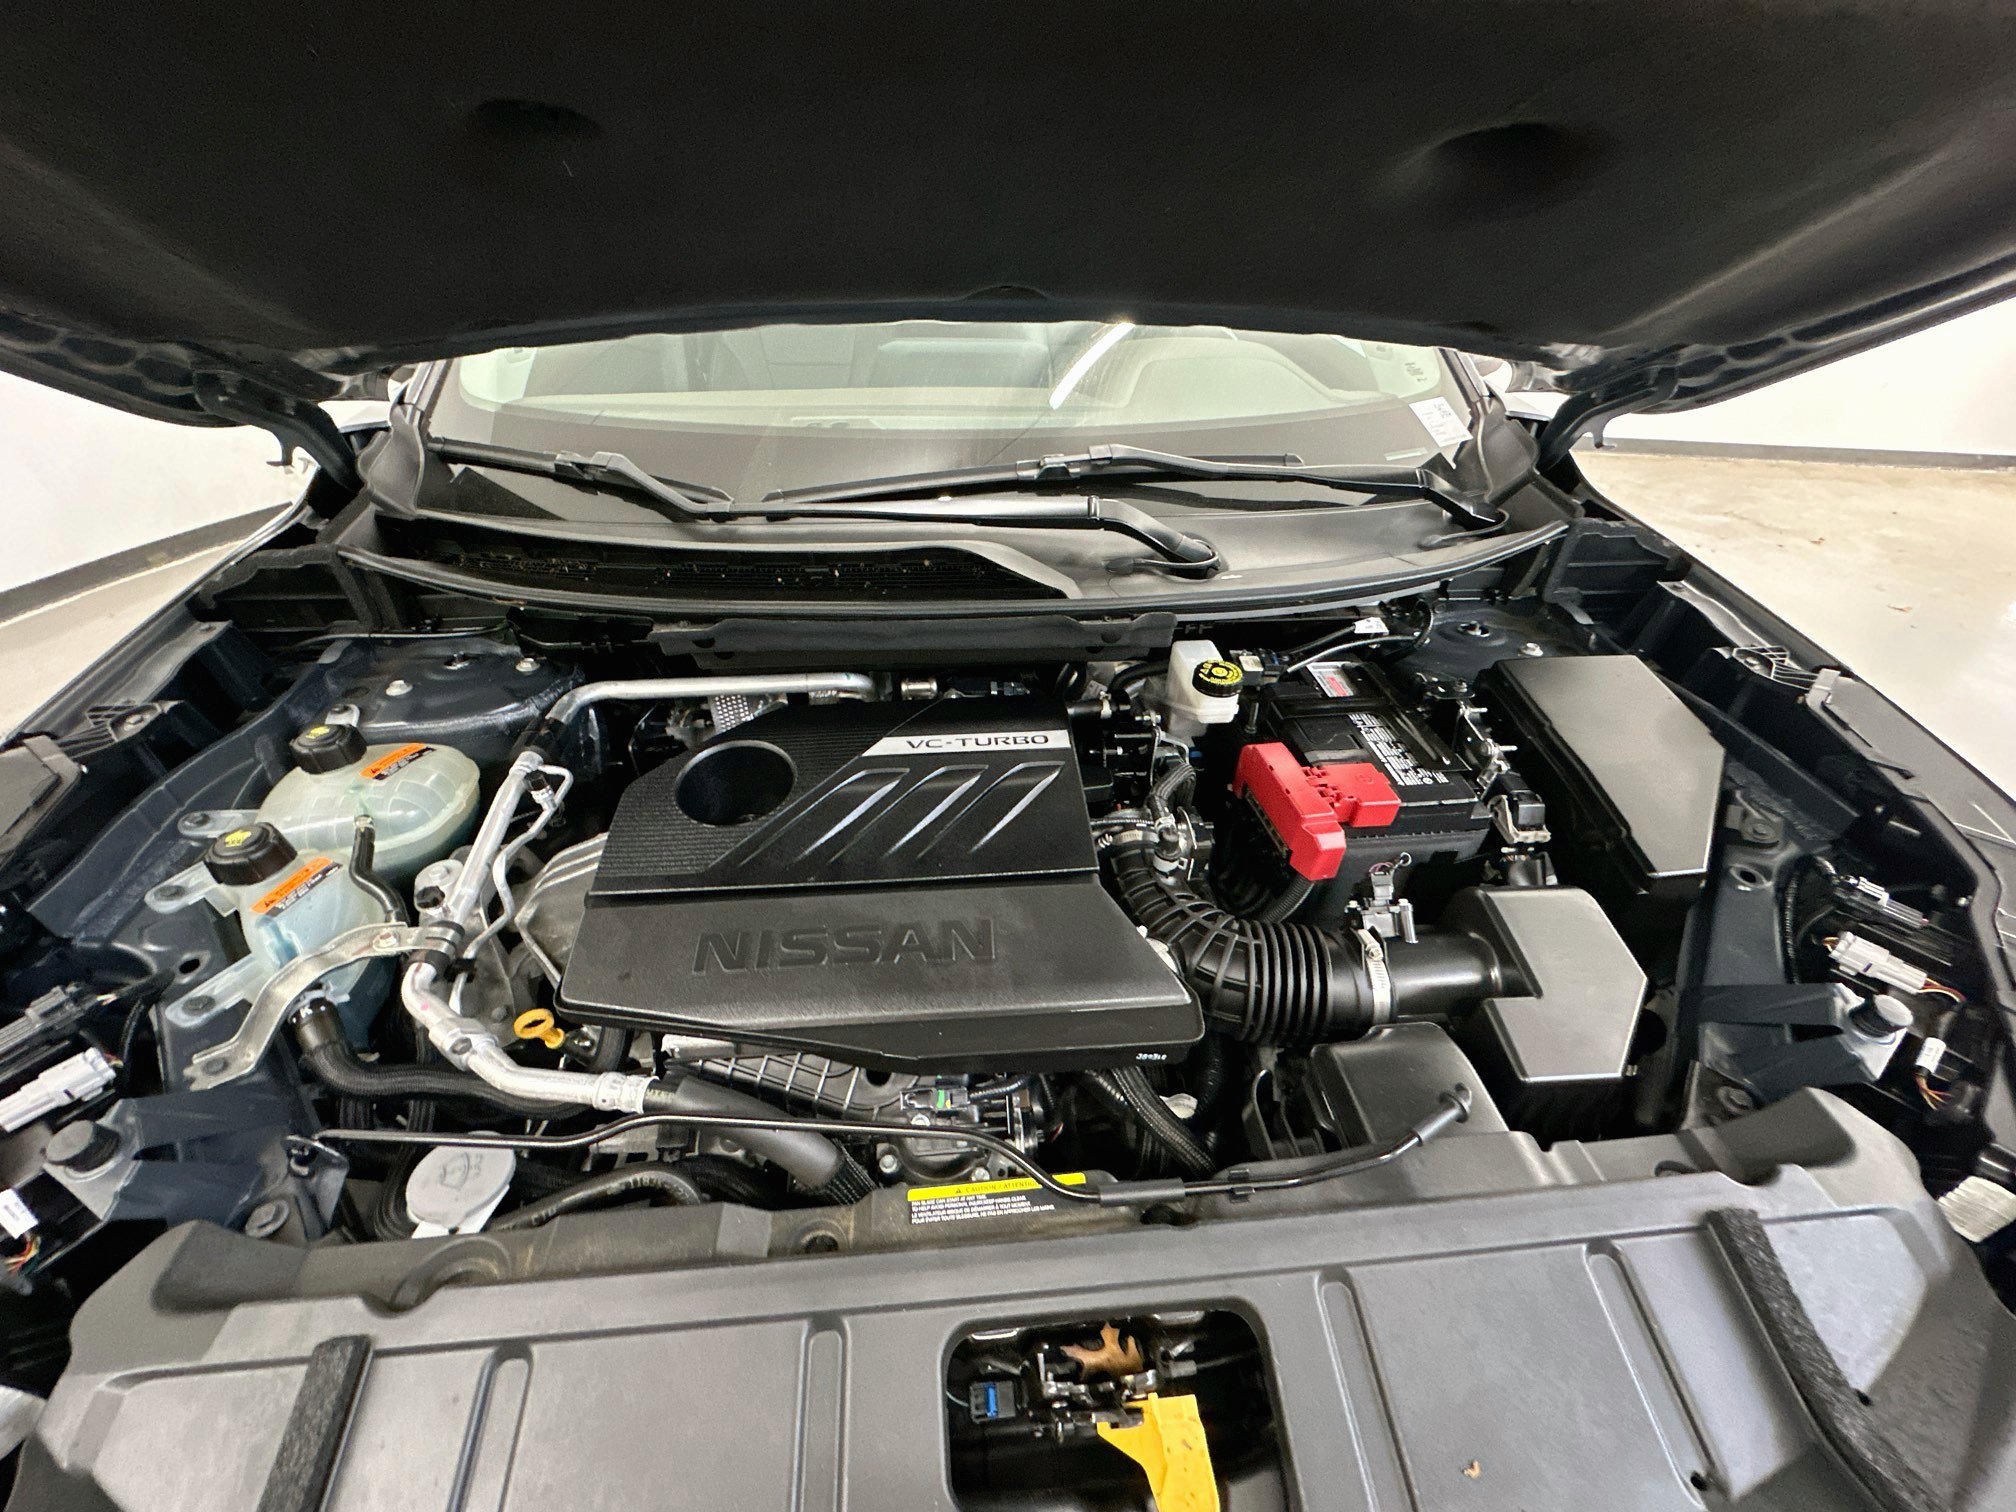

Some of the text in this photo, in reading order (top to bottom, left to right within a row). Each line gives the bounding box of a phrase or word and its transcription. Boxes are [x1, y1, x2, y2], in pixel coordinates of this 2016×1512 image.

[906, 734, 1049, 749] VC-TURBO
[692, 918, 996, 975] NISSAN
[966, 1183, 997, 1193] CAUTION
